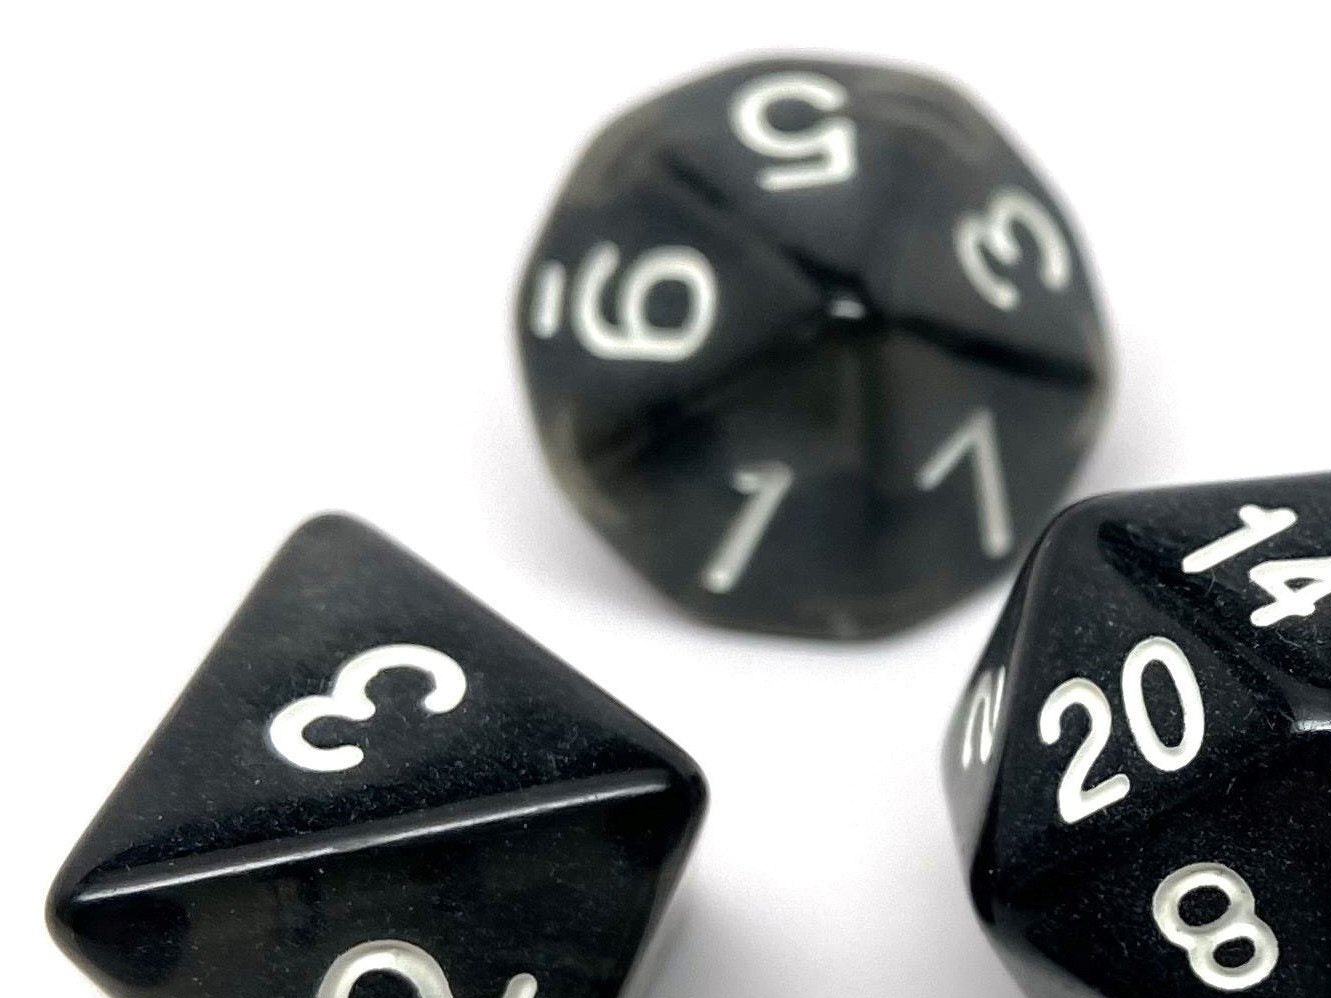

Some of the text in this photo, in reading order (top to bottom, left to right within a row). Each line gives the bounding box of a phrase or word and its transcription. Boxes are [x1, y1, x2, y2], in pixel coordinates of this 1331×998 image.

[728, 71, 858, 192] 5
[953, 186, 1071, 310] 3
[701, 461, 794, 593] 1
[917, 409, 1015, 558] 7
[268, 644, 466, 772] 3
[1040, 637, 1204, 823] 20
[1153, 863, 1278, 990] 8
